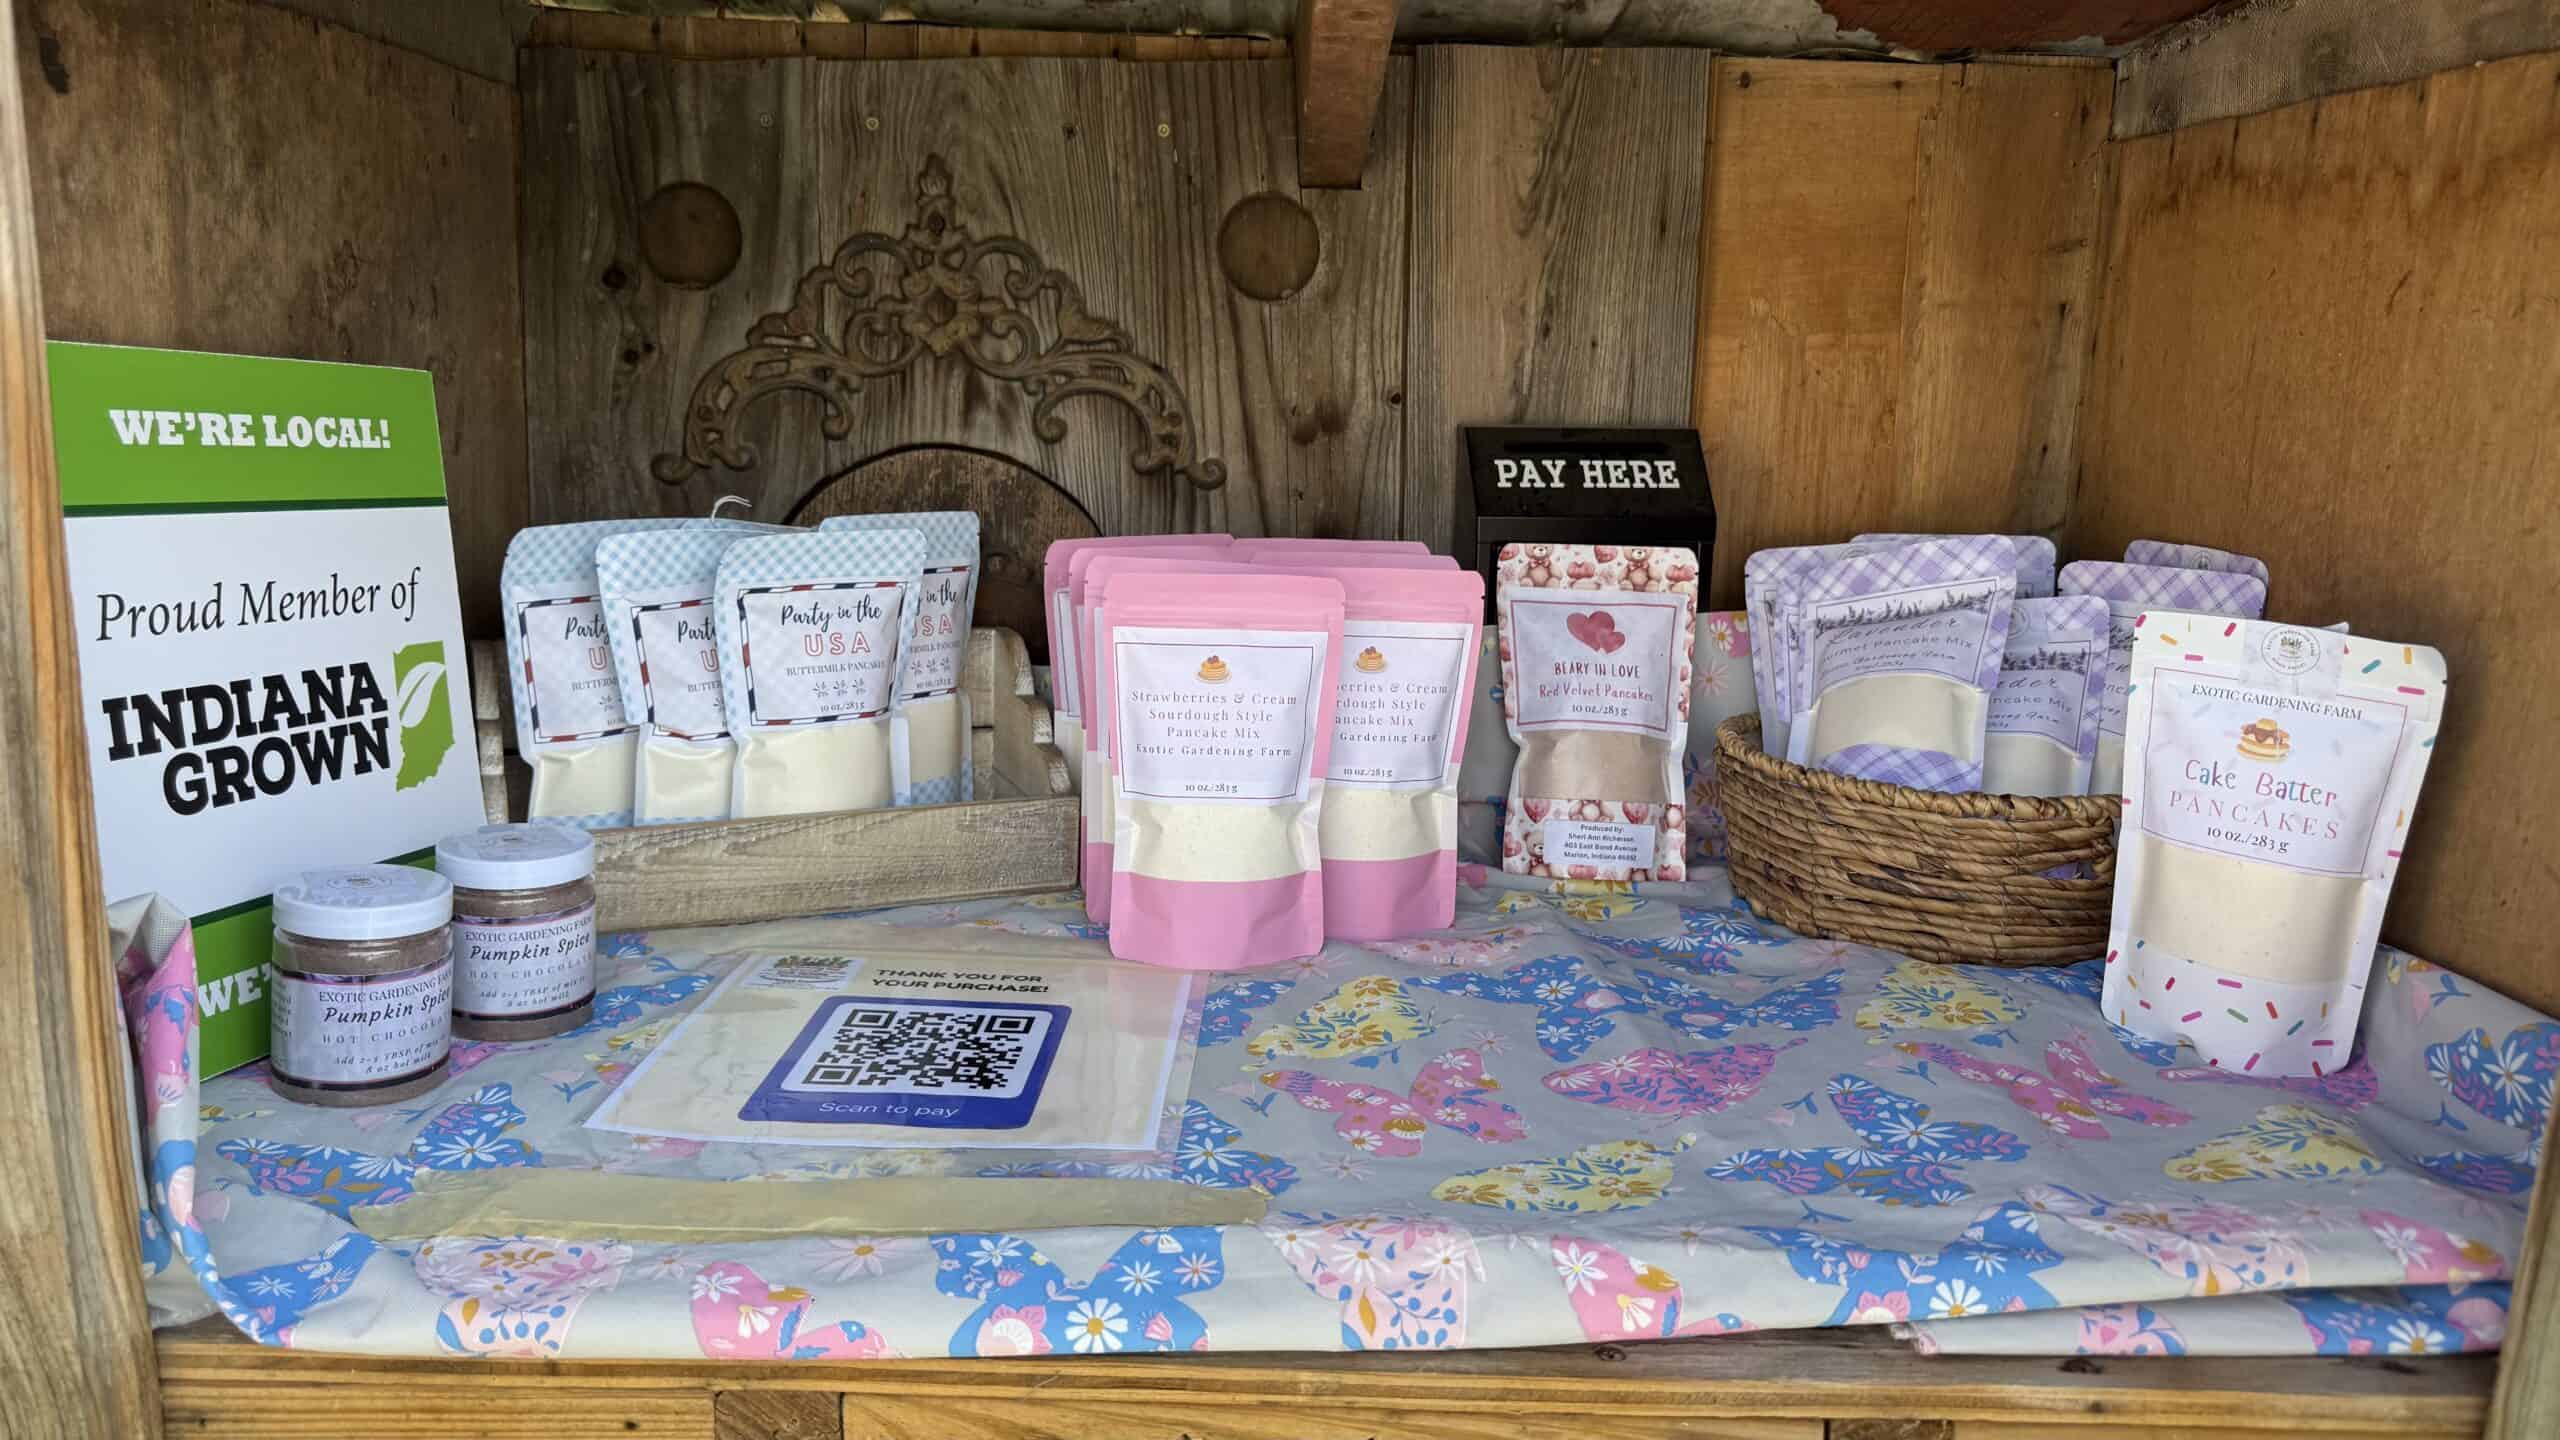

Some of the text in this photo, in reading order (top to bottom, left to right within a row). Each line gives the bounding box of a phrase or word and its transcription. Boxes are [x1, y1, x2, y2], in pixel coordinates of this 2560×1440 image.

[109, 410, 391, 449] WE’RE LOCAL!
[1494, 459, 1680, 489] PAY HERE
[96, 566, 421, 642] Proud Member of
[781, 593, 882, 632] Party in the
[804, 631, 871, 657] USA
[786, 663, 846, 677] BUTTERMILK
[1554, 662, 1640, 679] BEARY IN LOVE
[1131, 690, 1298, 706] Strawberries & Cream
[1390, 685, 1400, 694] &
[1406, 683, 1449, 695] Cream
[1539, 683, 1560, 698] Red
[1563, 682, 1600, 697] Velvet
[1392, 699, 1427, 714] Style
[1572, 704, 1583, 713] 10
[2191, 683, 2362, 721] EXOTIC GARDENING FARM
[102, 662, 388, 761] INDIANA
[1149, 709, 1273, 724] Sourdough Style
[1390, 715, 1415, 727] Mix
[1167, 727, 1260, 739] Pancake Mix
[1340, 732, 1408, 745] Gardening
[1136, 743, 1293, 759] Exotic Gardening Farm
[163, 716, 391, 816] GROWN
[1185, 784, 1195, 792] 10
[1231, 785, 1238, 793] g
[2185, 758, 2337, 808] Cake Batter
[2169, 789, 2339, 840] PANCAKES
[2207, 826, 2290, 854] 10 oz./283 g
[465, 930, 507, 943] EXOTIC
[509, 923, 573, 941] GARDENING
[470, 931, 591, 964] Pumpkin Spice
[469, 969, 498, 980] HOT
[876, 969, 1043, 983] THANK YOU FOR
[319, 991, 366, 1002] EXOTIC
[369, 978, 437, 1001] GARDENING
[872, 978, 1049, 994] YOUR PURCHASE!
[324, 1002, 413, 1027] Pumpkin
[323, 1033, 359, 1045] HOT
[371, 1016, 447, 1042] CHOCOLA
[818, 1101, 960, 1119] Scan to pay
